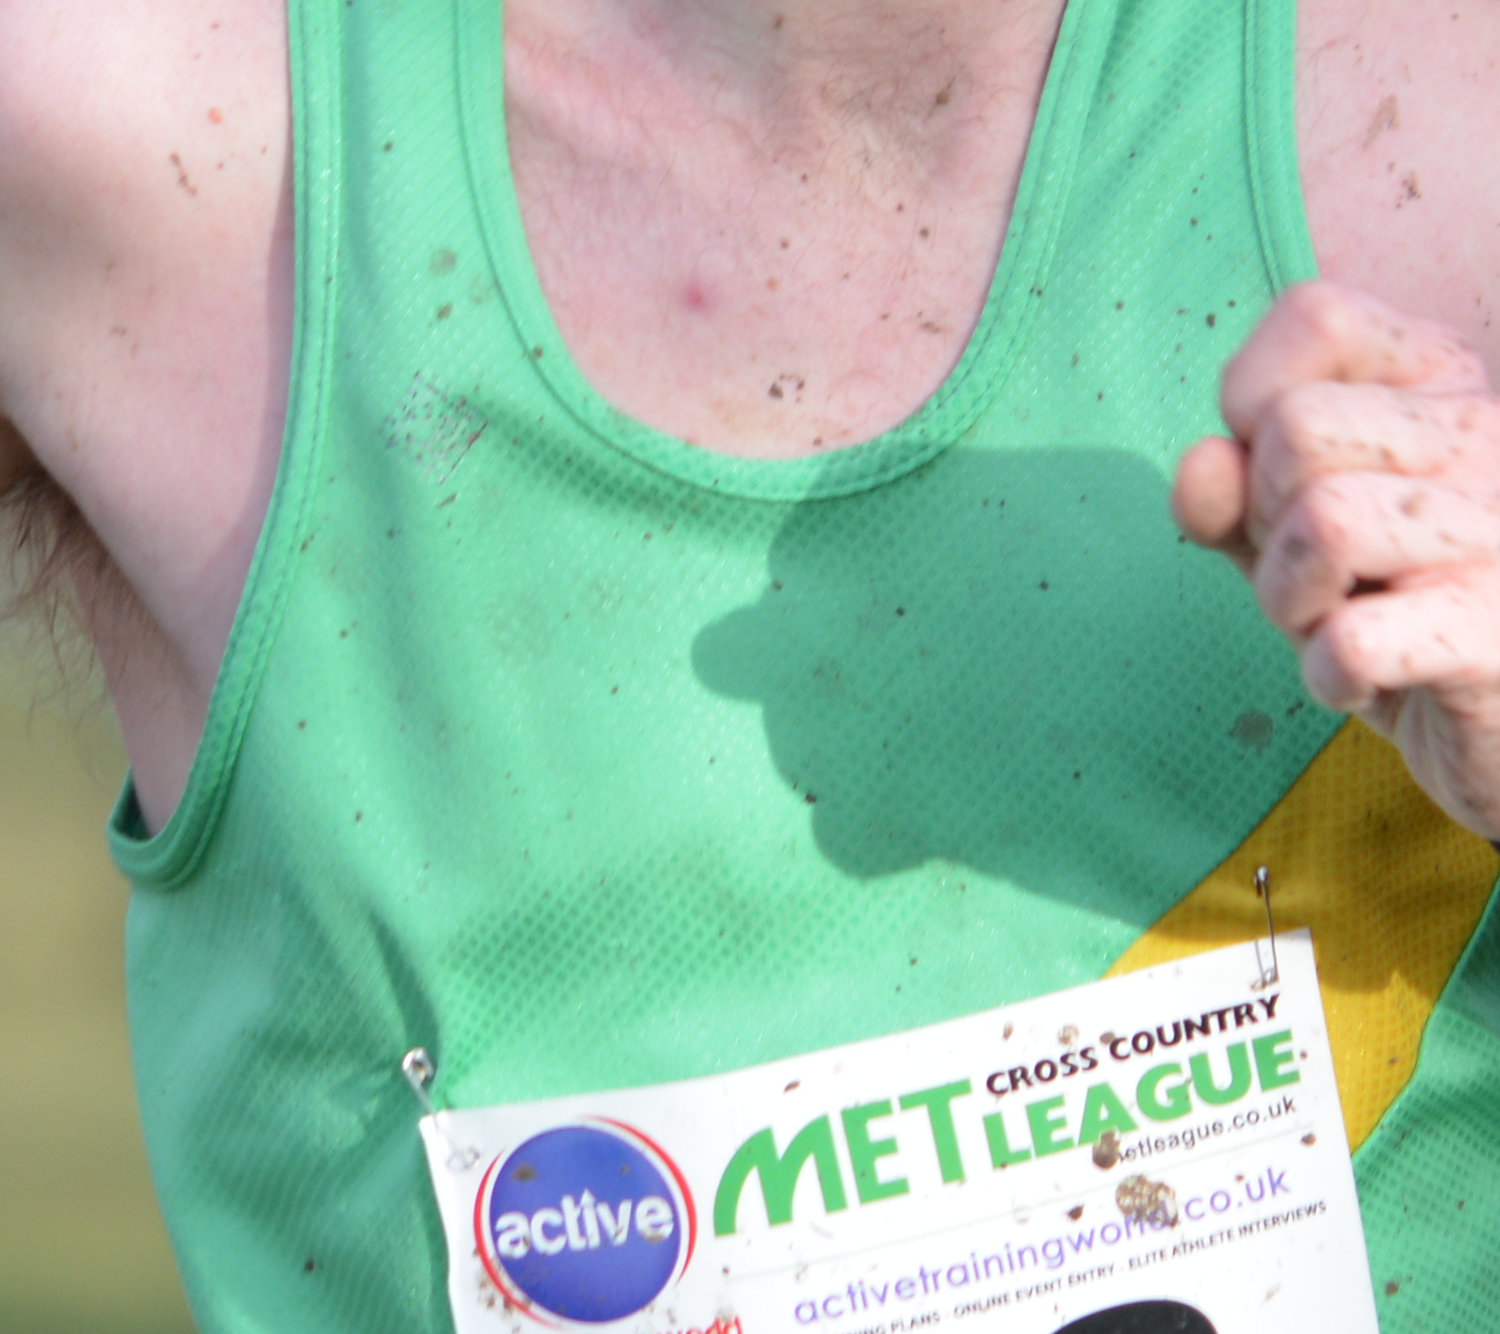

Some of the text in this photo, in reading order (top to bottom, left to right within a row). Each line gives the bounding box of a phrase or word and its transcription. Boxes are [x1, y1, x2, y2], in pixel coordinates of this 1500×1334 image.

[986, 994, 1280, 1096] CROSS COUNTRY
[713, 1029, 1301, 1238] MET LEAGUE
[1103, 1096, 1296, 1163] etleague.co.uk
[496, 1188, 674, 1259] active
[890, 1310, 942, 1334] PLANS
[953, 1293, 1011, 1318] ONLINE
[1015, 1278, 1062, 1302] EVENT
[1068, 1263, 1115, 1288] ENTRY
[1128, 1248, 1168, 1272] ELITE
[1171, 1228, 1235, 1259] ATHLETE
[1238, 1200, 1328, 1240] INTERVIEWS
